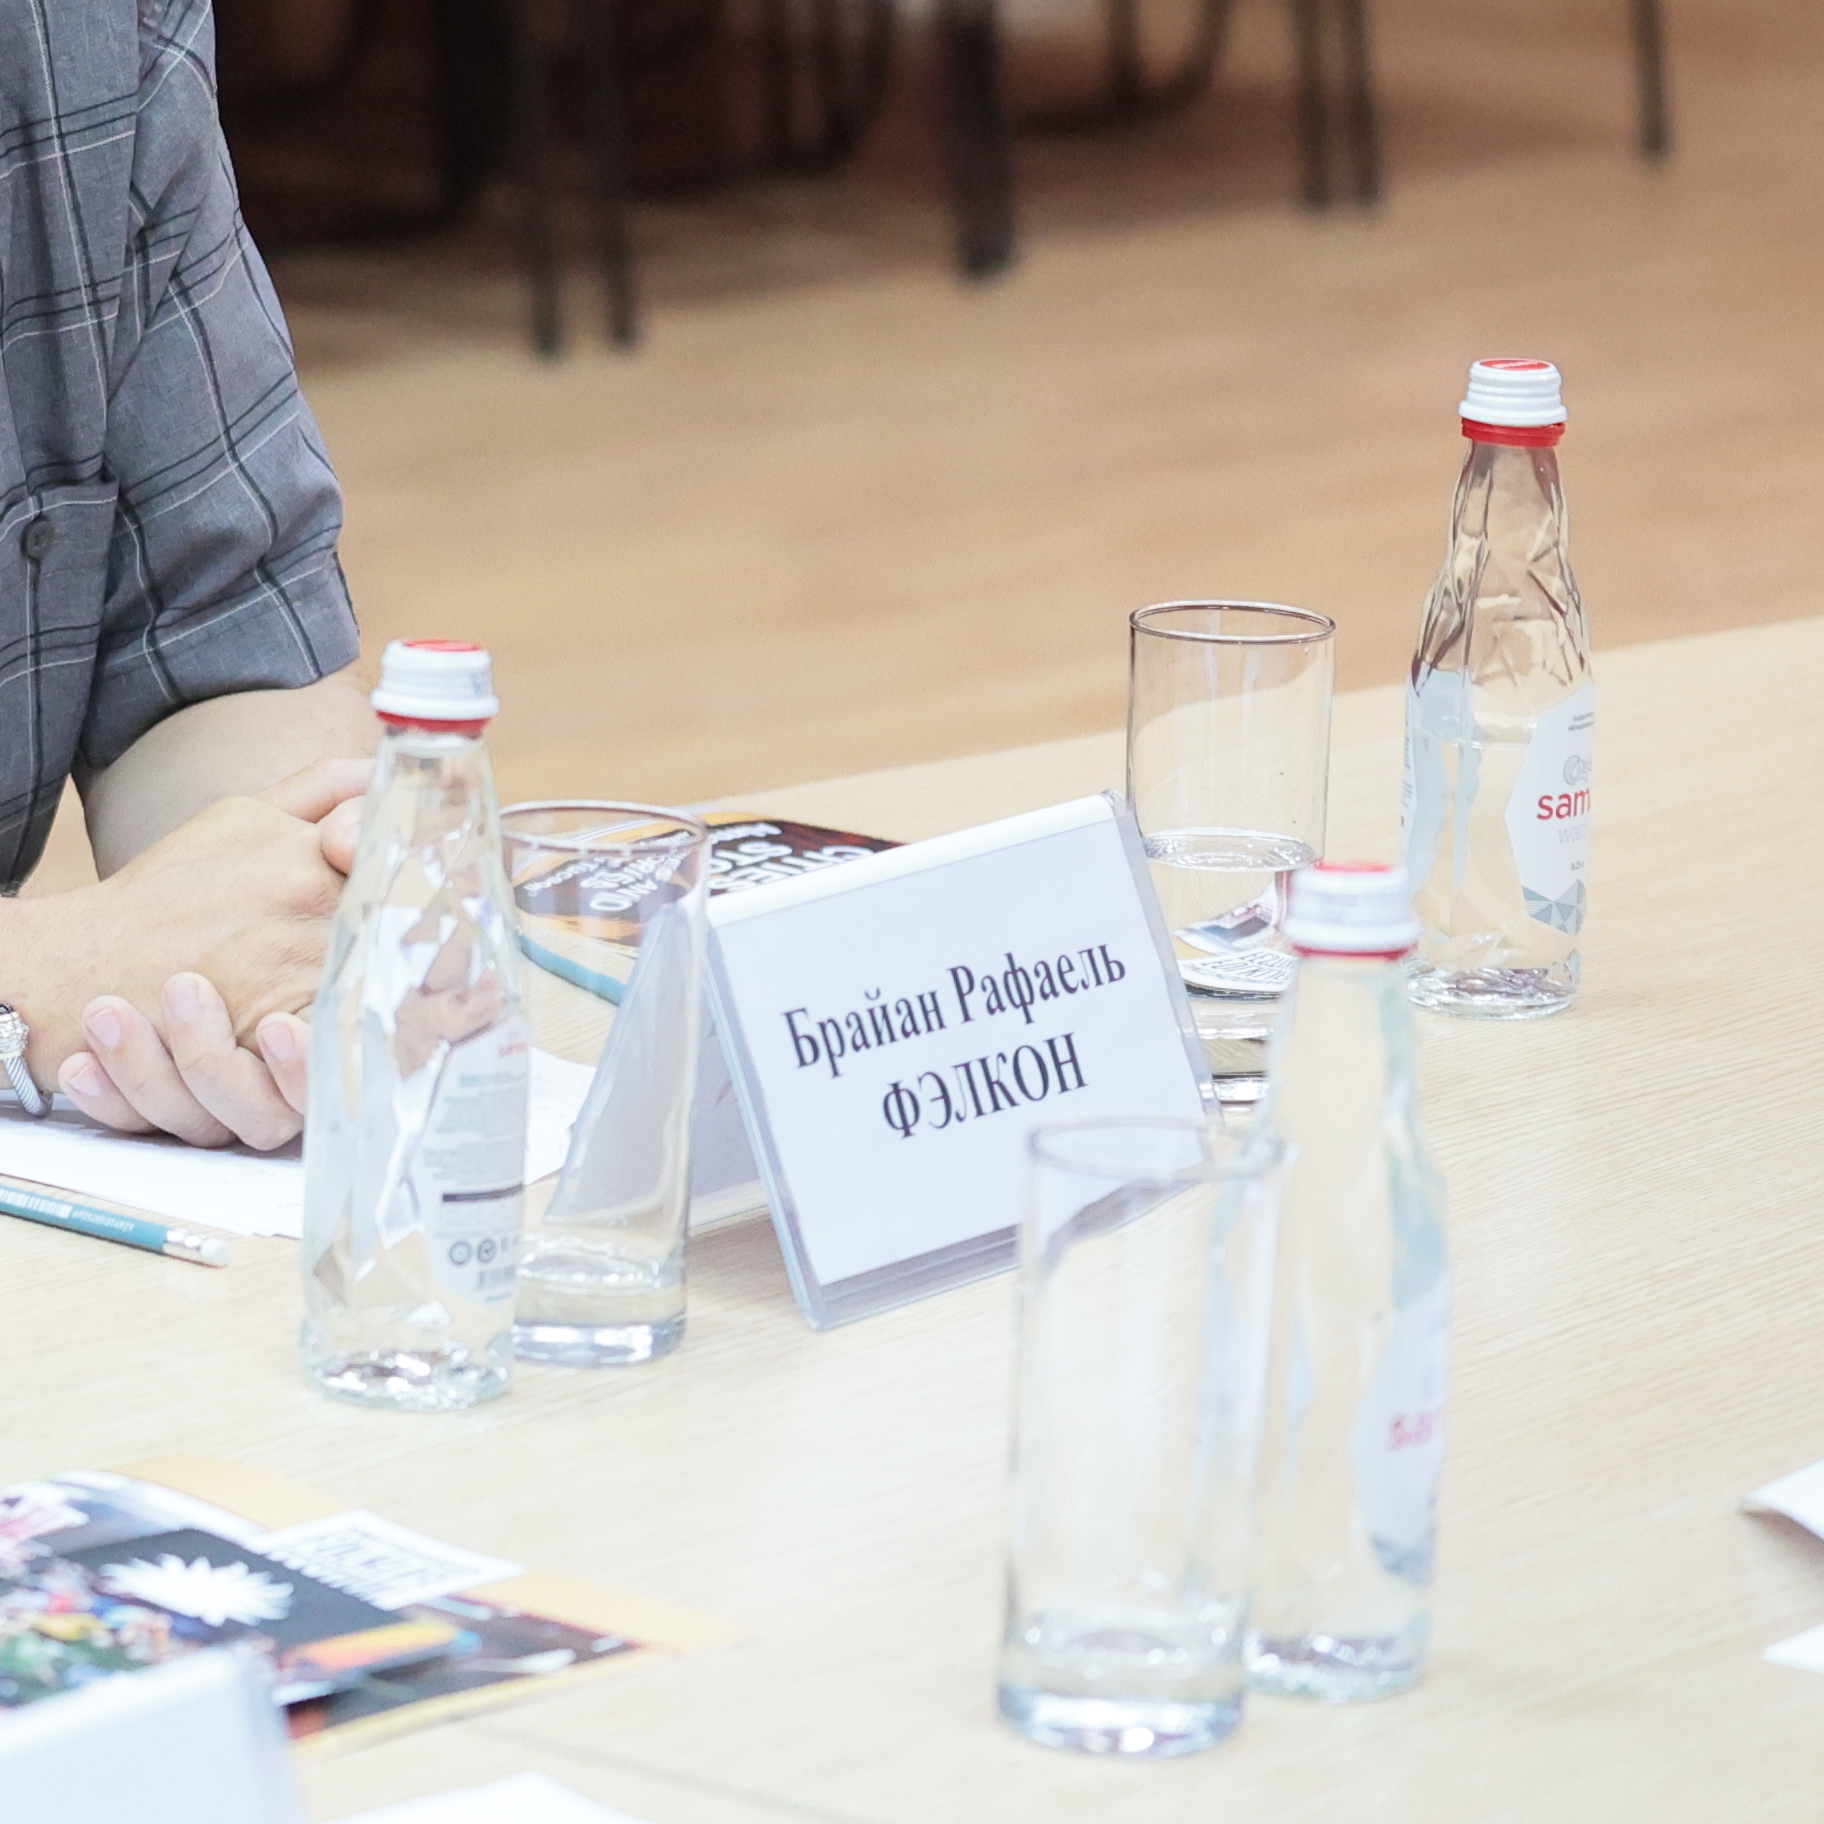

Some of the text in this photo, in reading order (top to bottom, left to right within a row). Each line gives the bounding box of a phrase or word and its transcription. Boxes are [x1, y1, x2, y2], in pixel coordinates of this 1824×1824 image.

[781, 944, 1127, 1078] Брайан Рафаель
[882, 1032, 1089, 1139] ФЭЛКОН
